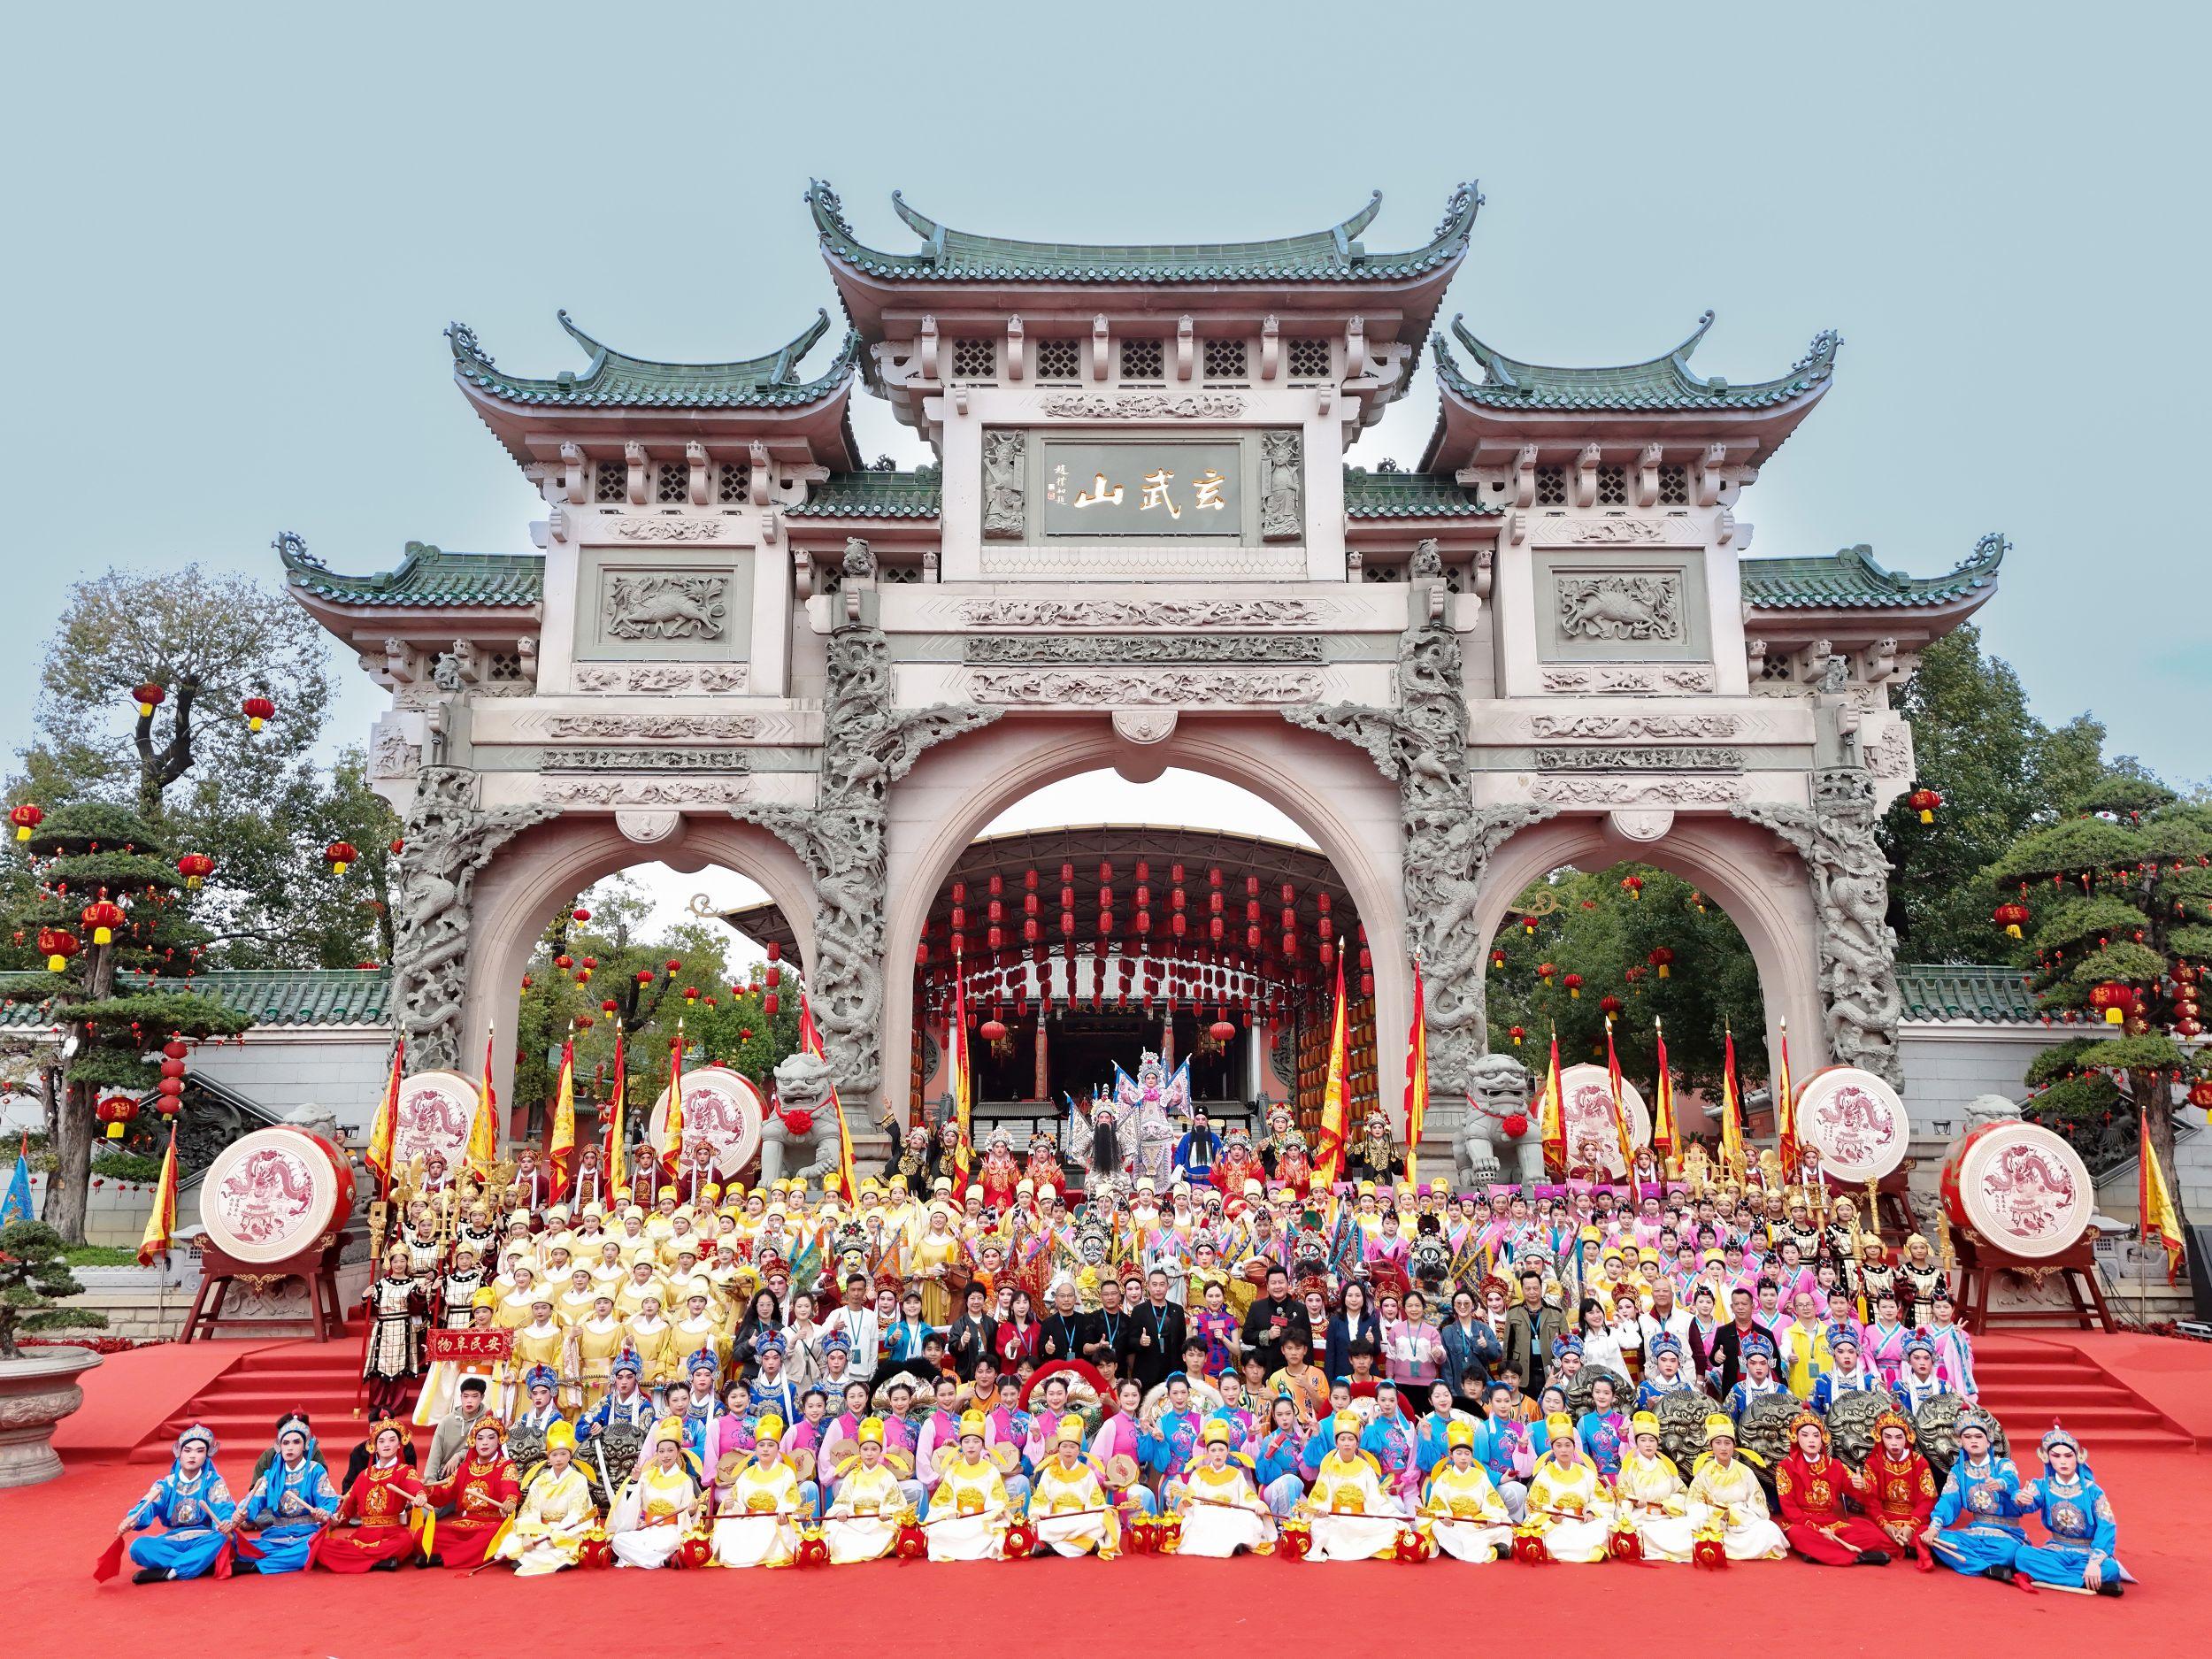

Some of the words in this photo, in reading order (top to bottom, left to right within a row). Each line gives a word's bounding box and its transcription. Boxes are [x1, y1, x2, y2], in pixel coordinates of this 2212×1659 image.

[1073, 467, 1225, 519] 玄武山
[437, 1335, 502, 1353] 物阜民安
